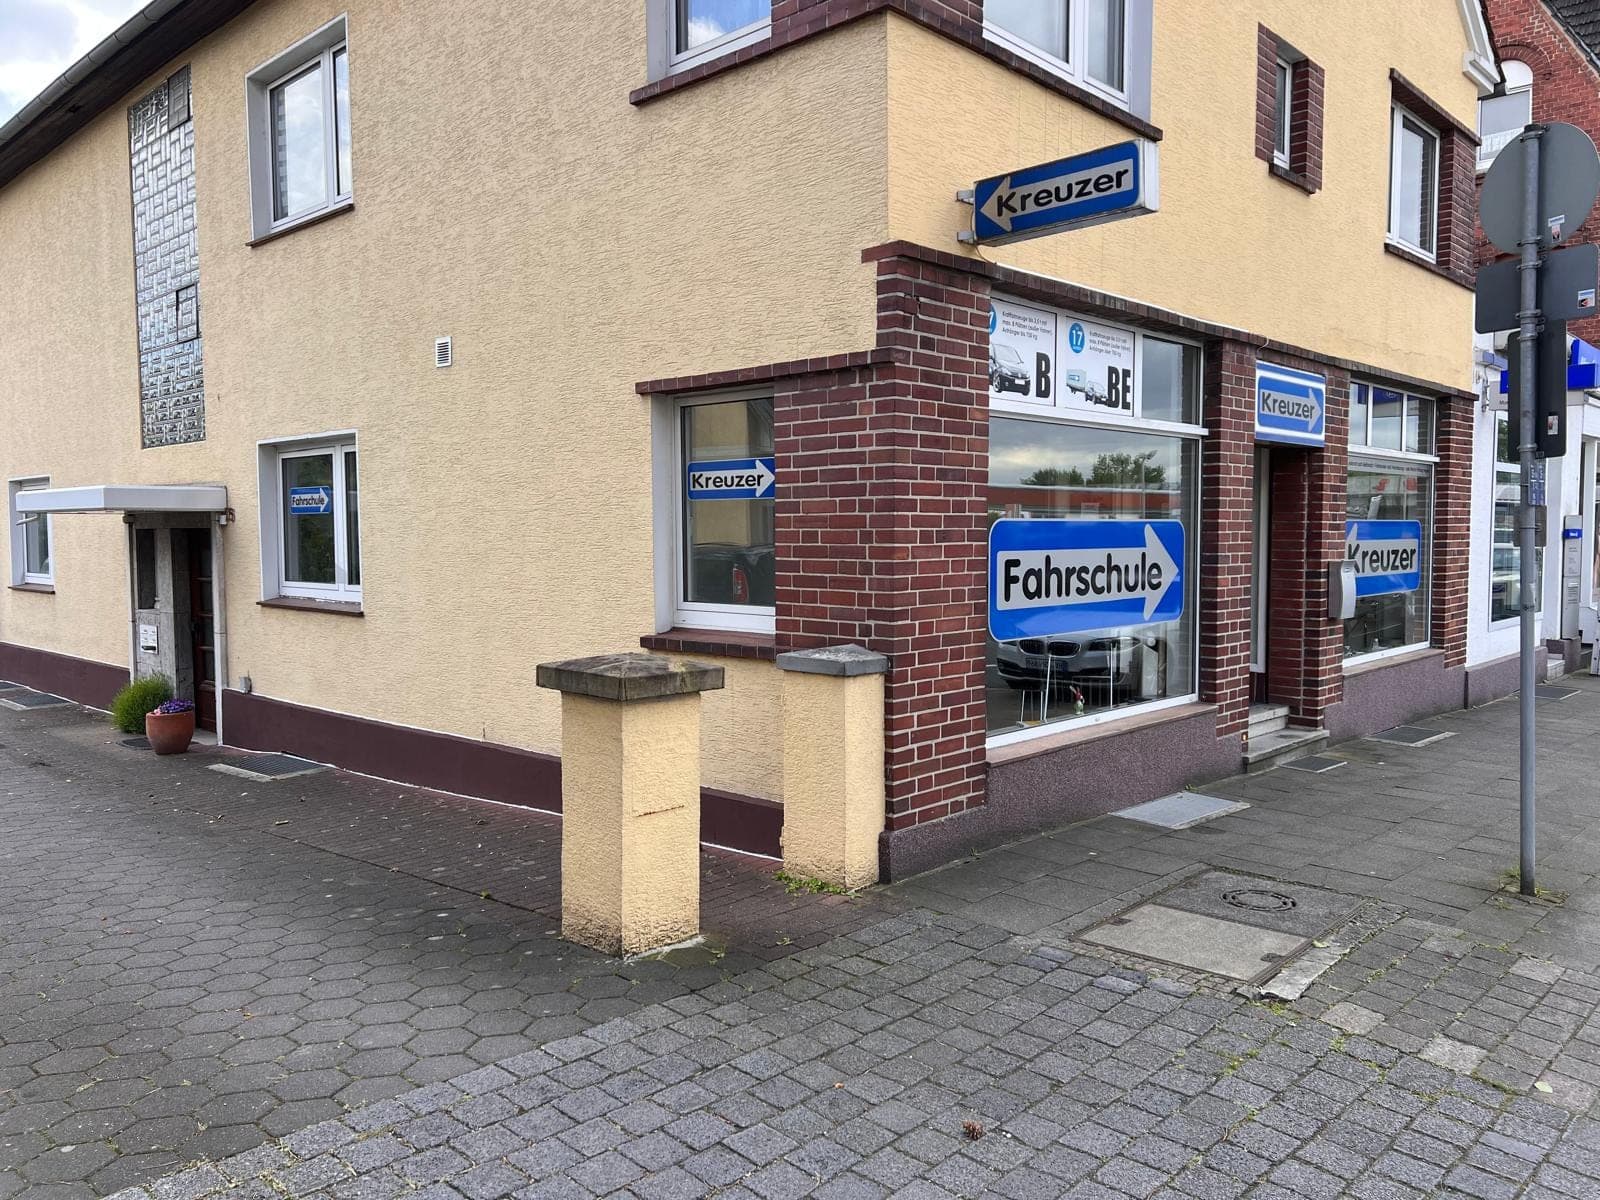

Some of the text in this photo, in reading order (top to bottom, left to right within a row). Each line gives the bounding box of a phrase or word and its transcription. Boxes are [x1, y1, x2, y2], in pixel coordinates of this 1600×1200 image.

[997, 168, 1129, 217] Kreuzer
[1072, 329, 1083, 346] 17
[1036, 351, 1051, 398] B
[1107, 365, 1131, 410] BE
[1262, 391, 1316, 419] Kreuzer
[691, 473, 764, 489] Kreuzer
[292, 494, 326, 505] Fahrschule
[1347, 543, 1416, 574] Kreuzer
[1004, 551, 1163, 602] Fahrschule
